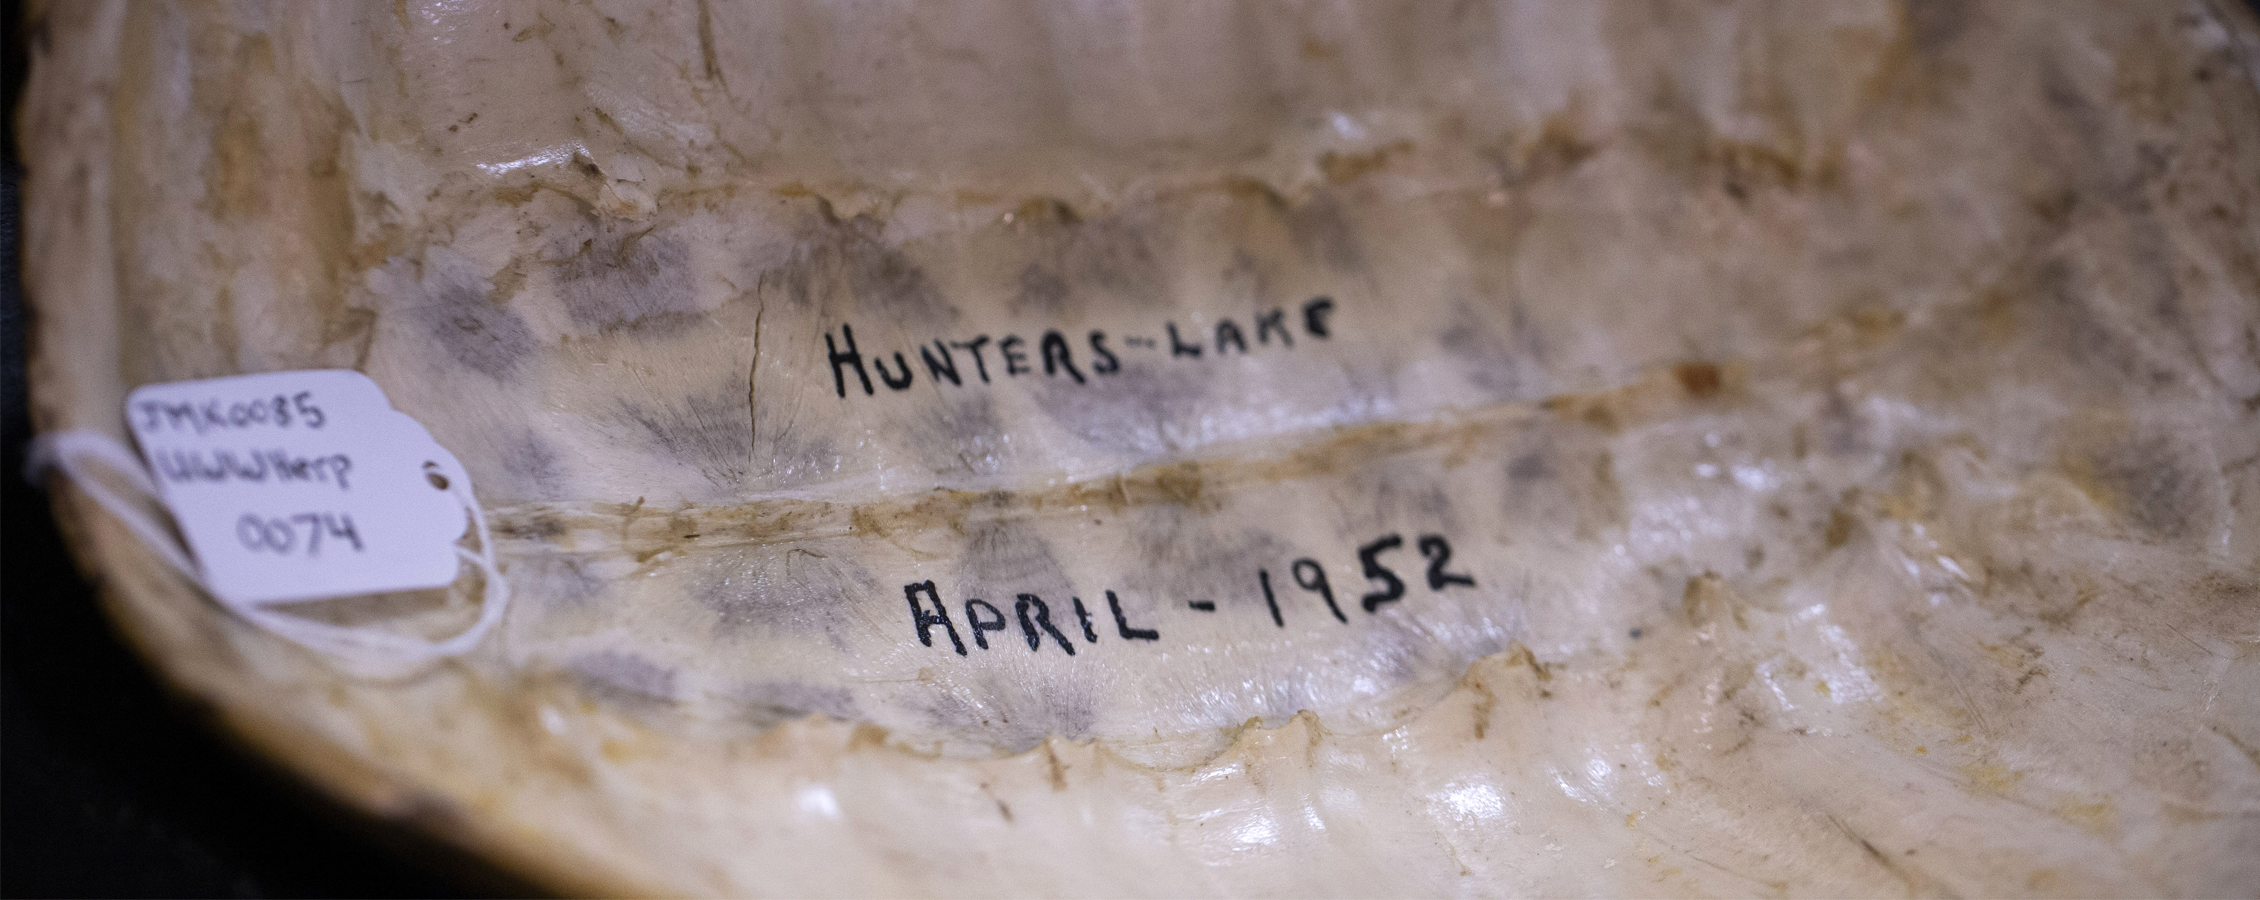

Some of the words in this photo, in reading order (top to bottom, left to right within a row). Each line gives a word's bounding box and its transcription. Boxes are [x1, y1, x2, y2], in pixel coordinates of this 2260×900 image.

[236, 512, 364, 558] 0074
[904, 580, 1160, 656] APRIL
[1257, 534, 1476, 626] 1952
